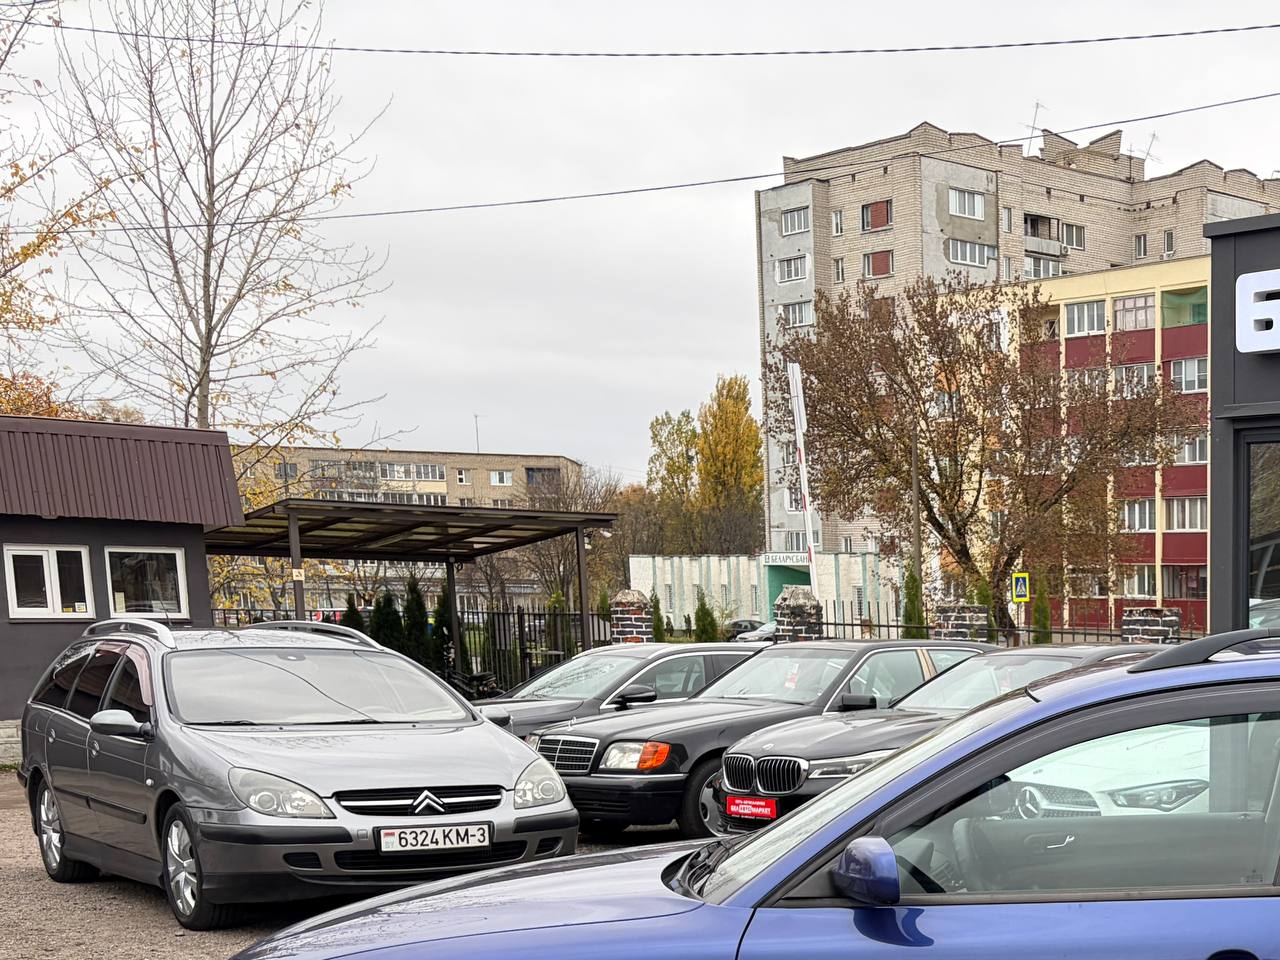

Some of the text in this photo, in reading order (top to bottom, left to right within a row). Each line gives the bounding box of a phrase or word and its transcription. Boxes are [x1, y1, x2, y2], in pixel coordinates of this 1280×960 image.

[771, 554, 810, 563] БЕЛАРУСБАН
[398, 827, 486, 848] 6324 KM-3
